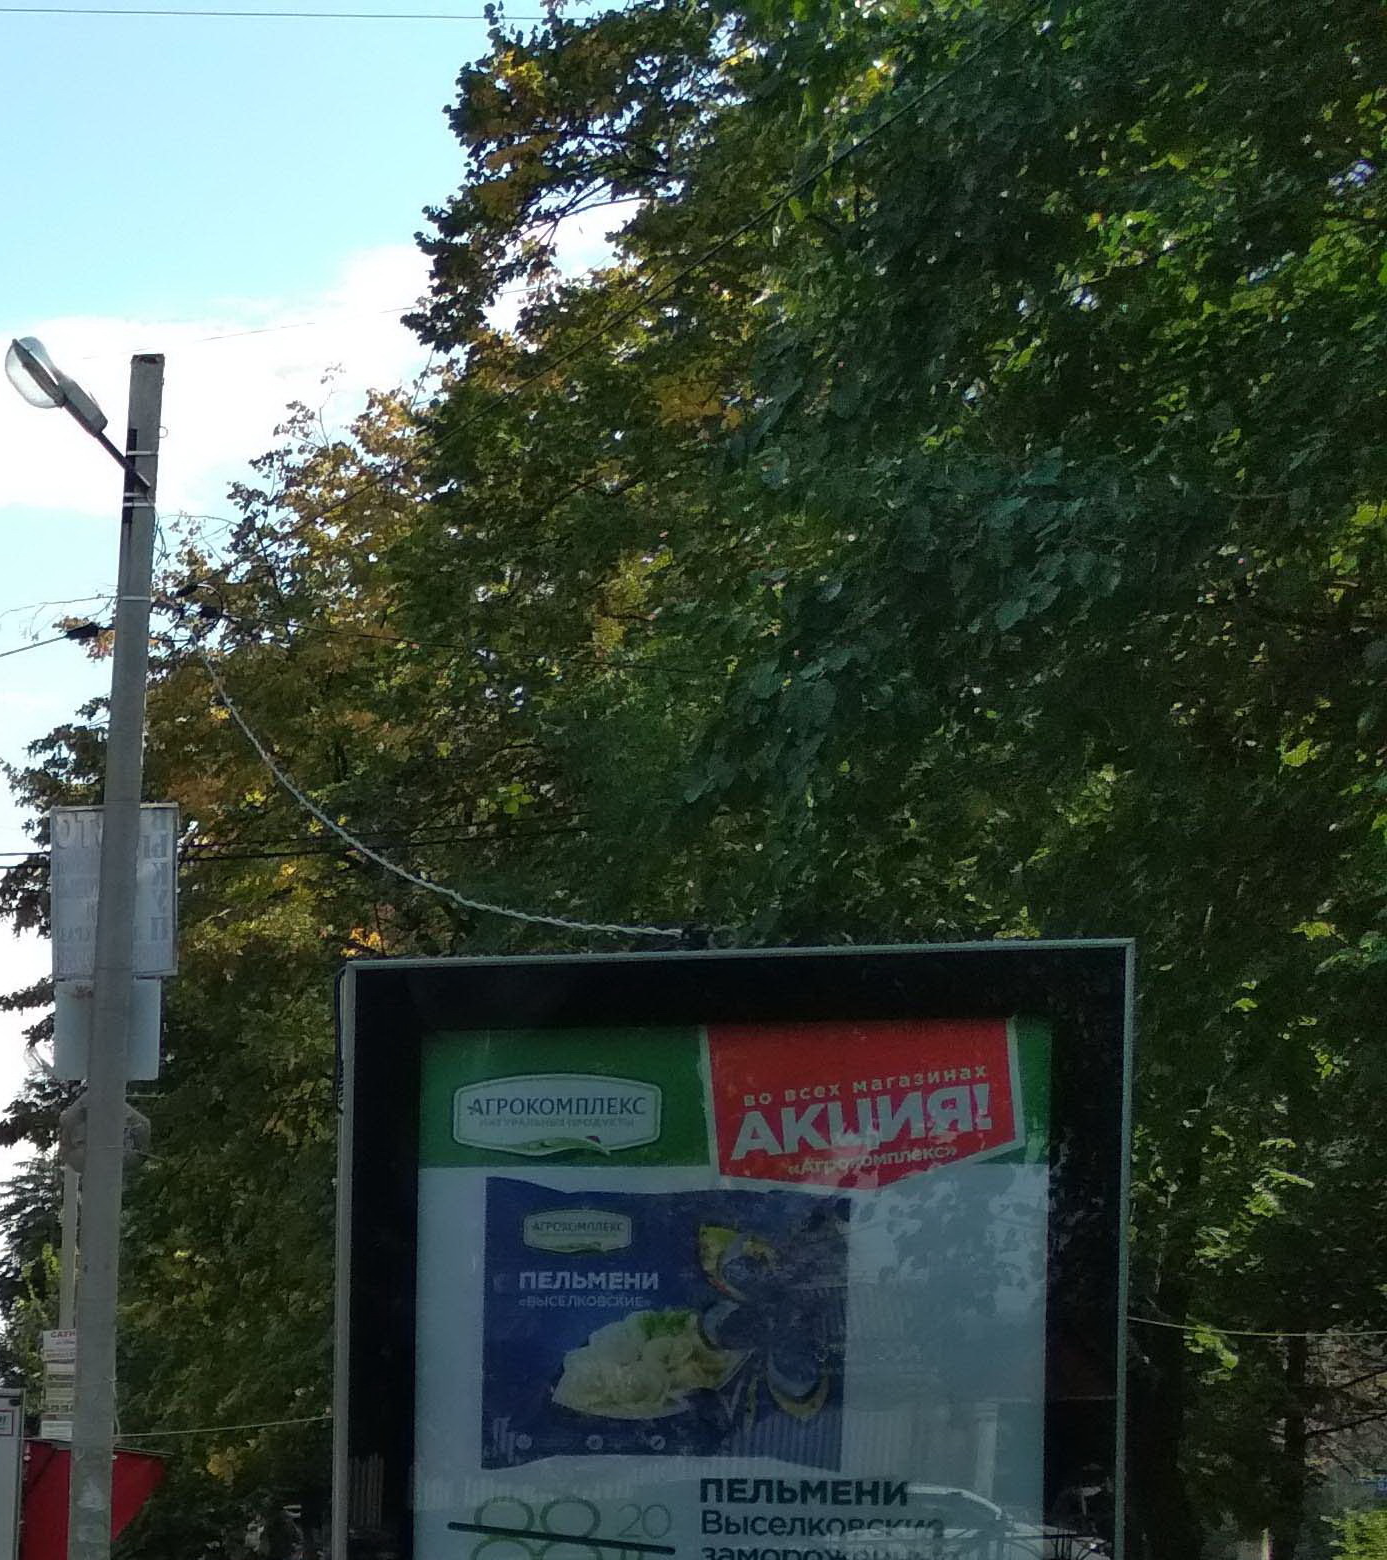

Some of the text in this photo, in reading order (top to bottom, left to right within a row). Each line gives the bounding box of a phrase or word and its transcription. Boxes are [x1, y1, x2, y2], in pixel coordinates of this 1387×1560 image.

[744, 1065, 986, 1107] во всех магазинах
[467, 1096, 646, 1117] АГРОКОМПЛЕКС
[731, 1083, 992, 1160] АКЦИЯ!
[531, 1220, 625, 1233] АГРОКОМПЛЕКС
[518, 1270, 659, 1290] ПЕЛЬМЕНИ
[699, 1478, 909, 1507] ПЕЛЬМЕНИ
